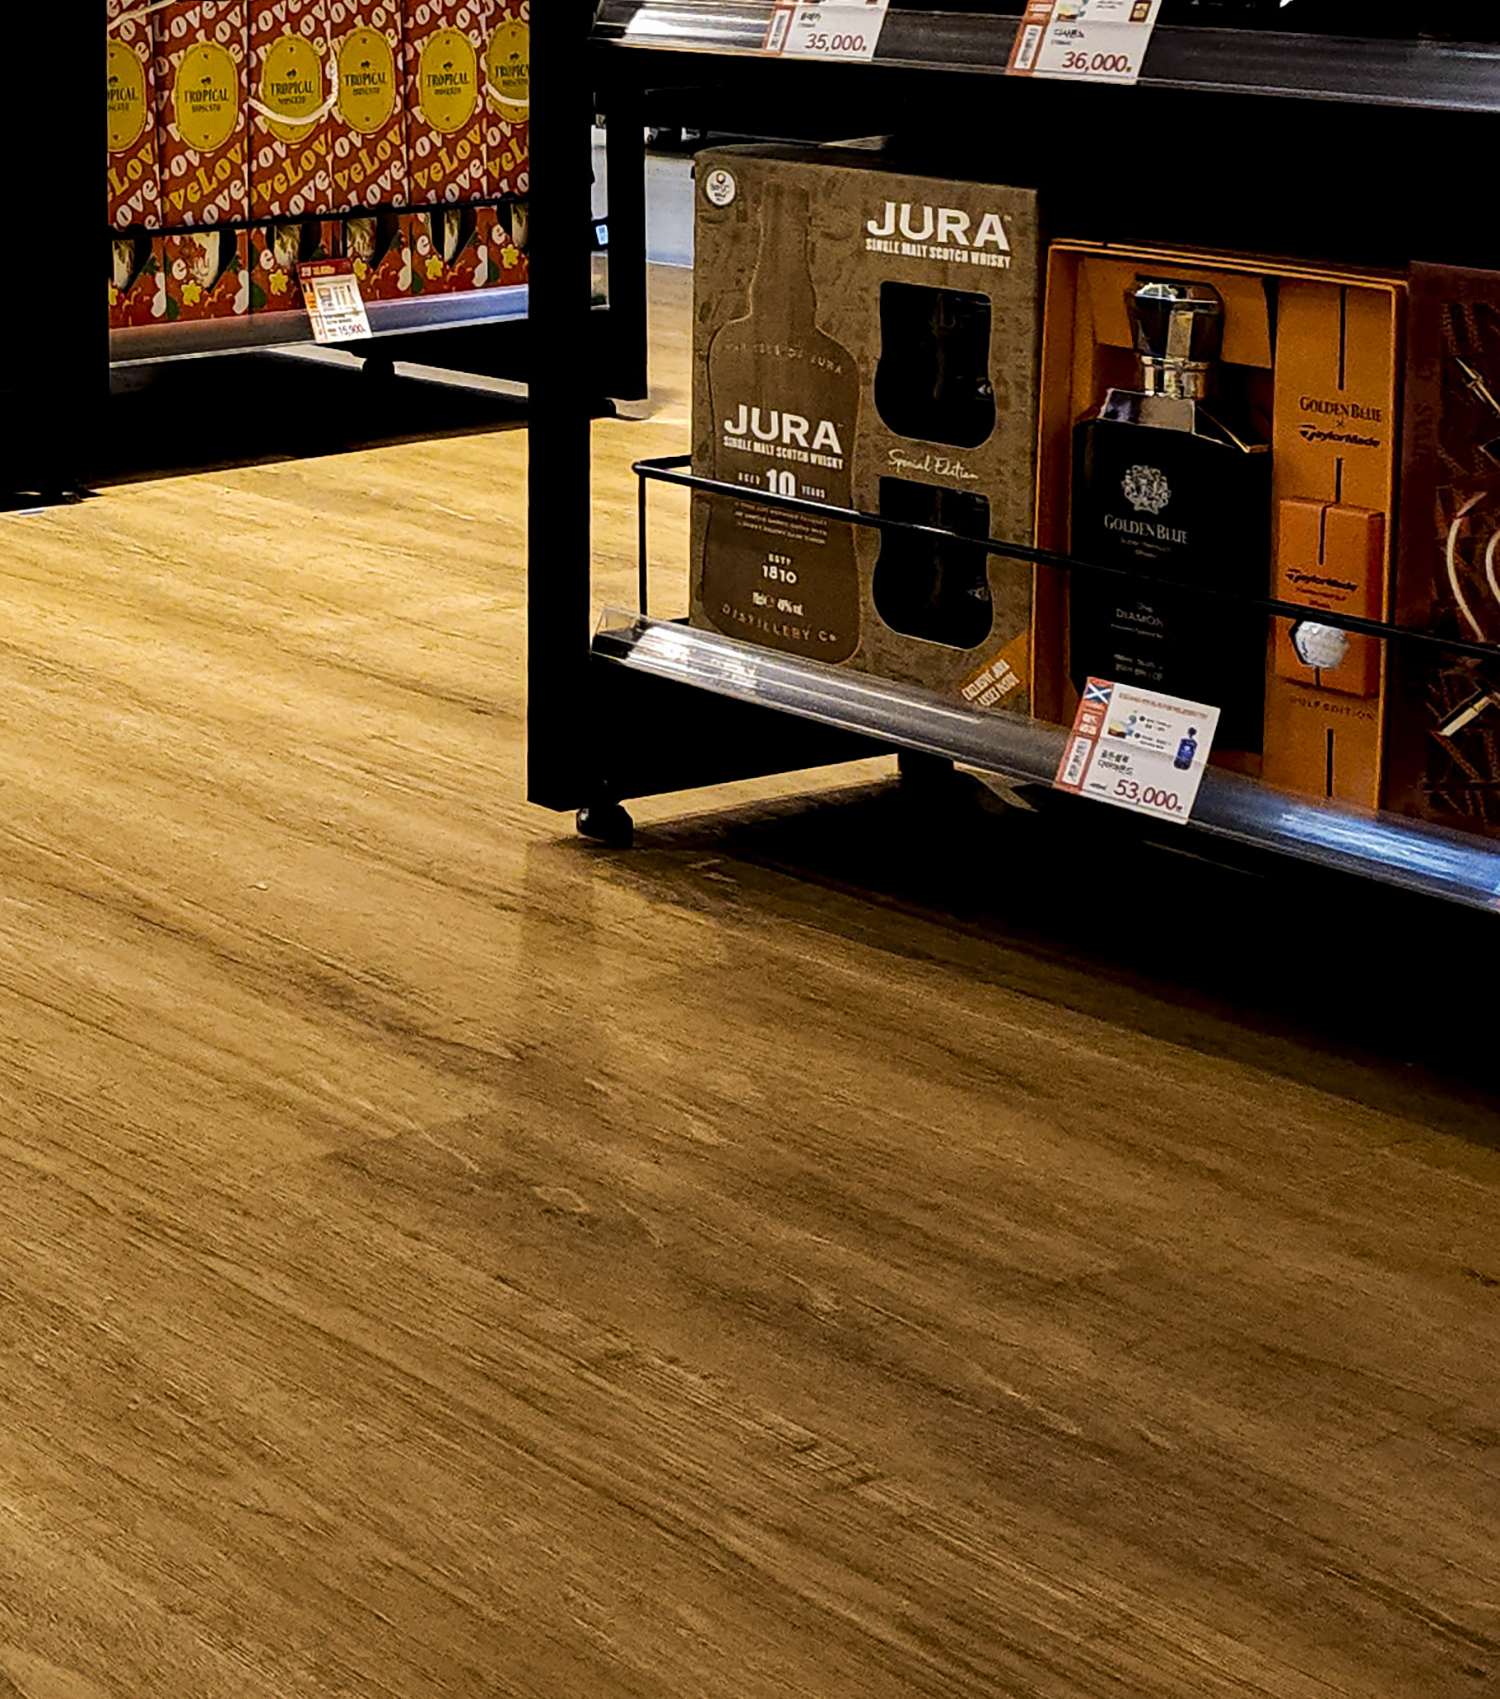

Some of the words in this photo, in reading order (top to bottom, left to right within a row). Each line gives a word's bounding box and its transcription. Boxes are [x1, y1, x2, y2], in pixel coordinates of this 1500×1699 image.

[270, 81, 314, 96] TROPICAL
[345, 72, 387, 87] TROPICAL
[427, 73, 470, 87] TROPICAL
[184, 89, 229, 103] TROPICAL
[867, 201, 1010, 251] JURA
[865, 238, 900, 255] SINGLE
[901, 242, 927, 258] MALT
[929, 246, 969, 264] SCOTCH
[970, 251, 1011, 269] WHISKY
[724, 404, 842, 454] JURA
[1300, 425, 1380, 448] TaylorMade
[723, 435, 752, 452] SINGLE
[753, 441, 775, 456] MALT
[776, 444, 809, 463] SCOTCH
[810, 450, 843, 470] WHISKY
[766, 468, 796, 497] 10
[762, 565, 797, 584] 1810
[721, 603, 810, 641] DISTILLERY
